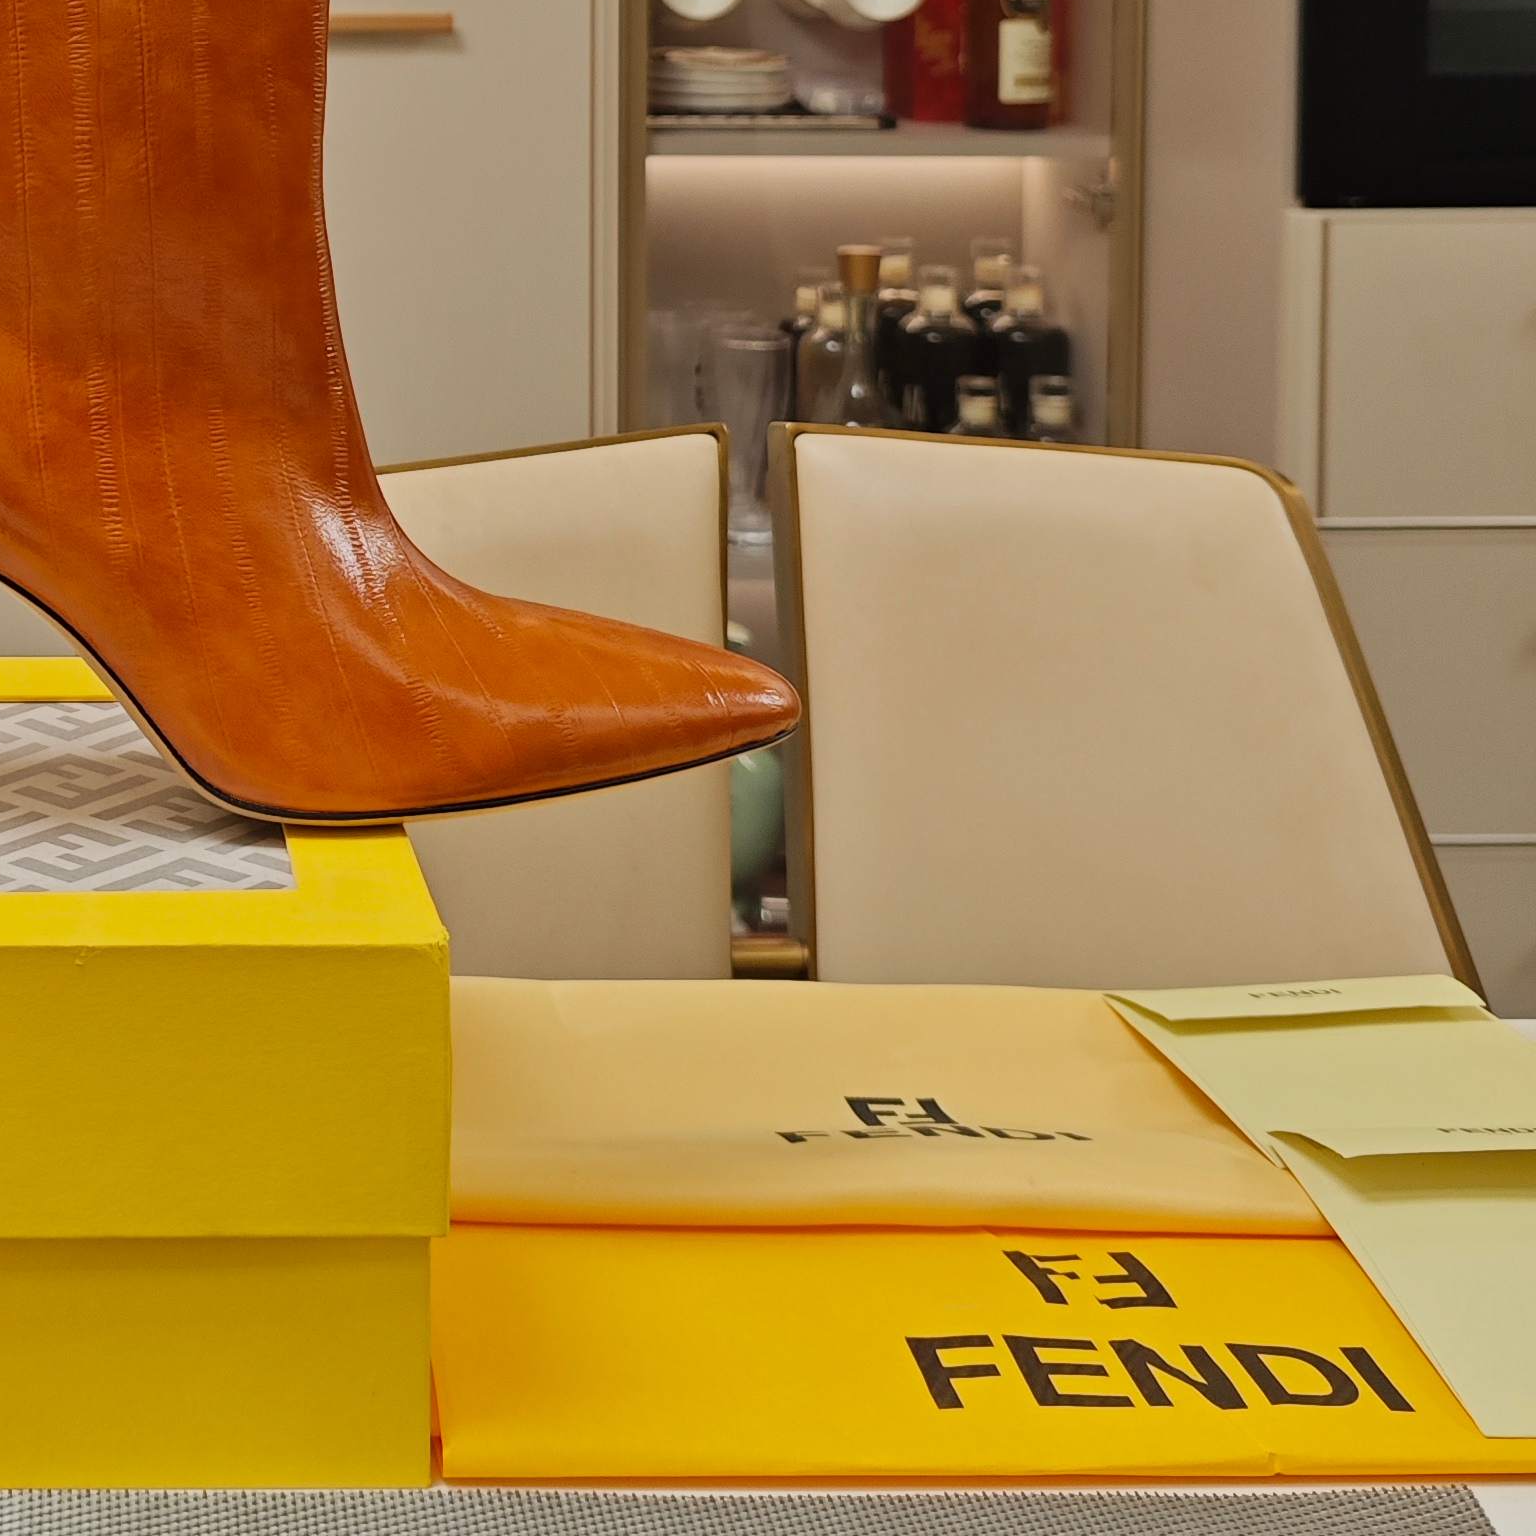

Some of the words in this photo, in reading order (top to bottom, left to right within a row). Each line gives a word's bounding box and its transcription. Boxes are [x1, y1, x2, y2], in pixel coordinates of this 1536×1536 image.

[1247, 988, 1344, 1000] FENDI
[774, 1125, 1093, 1144] FENDI
[1434, 1127, 1536, 1136] FEND
[906, 1335, 1414, 1411] FENDI
